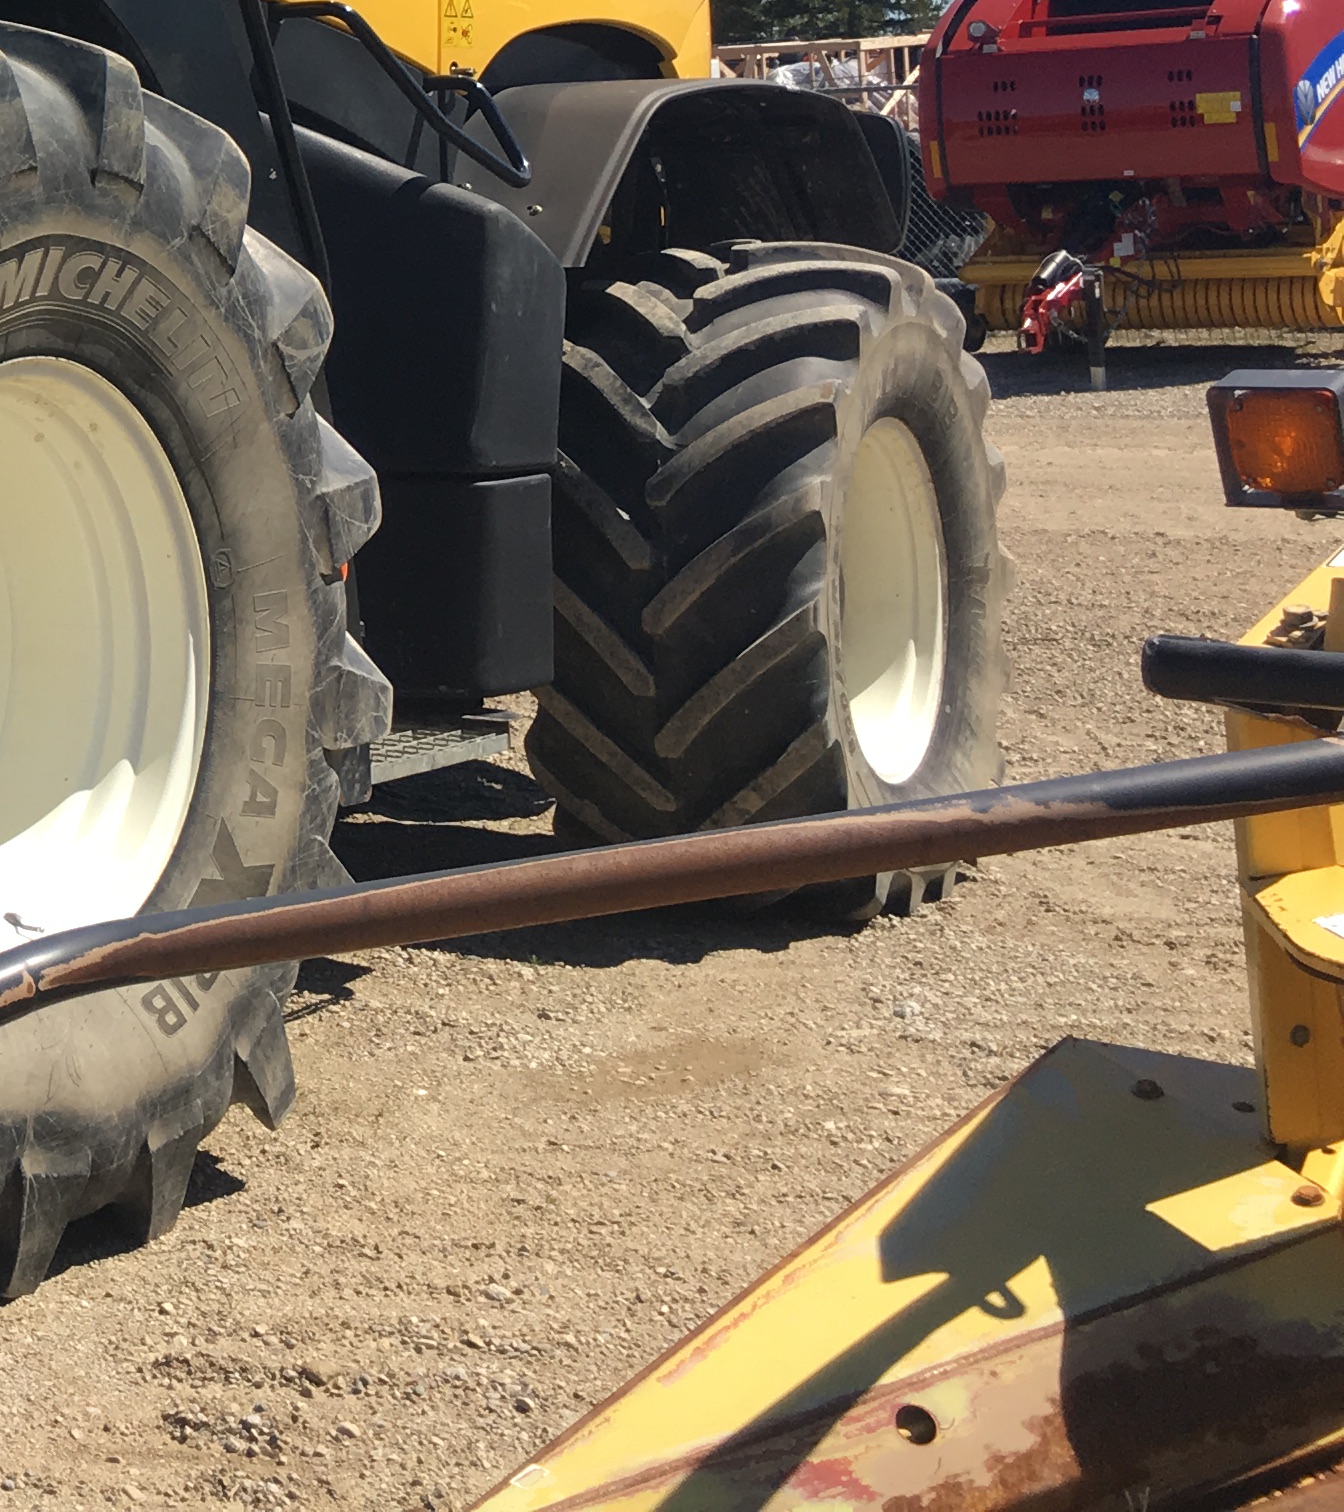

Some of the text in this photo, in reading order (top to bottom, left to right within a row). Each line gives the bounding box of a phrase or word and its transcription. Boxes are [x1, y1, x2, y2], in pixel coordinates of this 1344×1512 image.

[1316, 64, 1337, 103] NEW
[239, 589, 292, 820] MEGA
[141, 970, 220, 1039] IB
